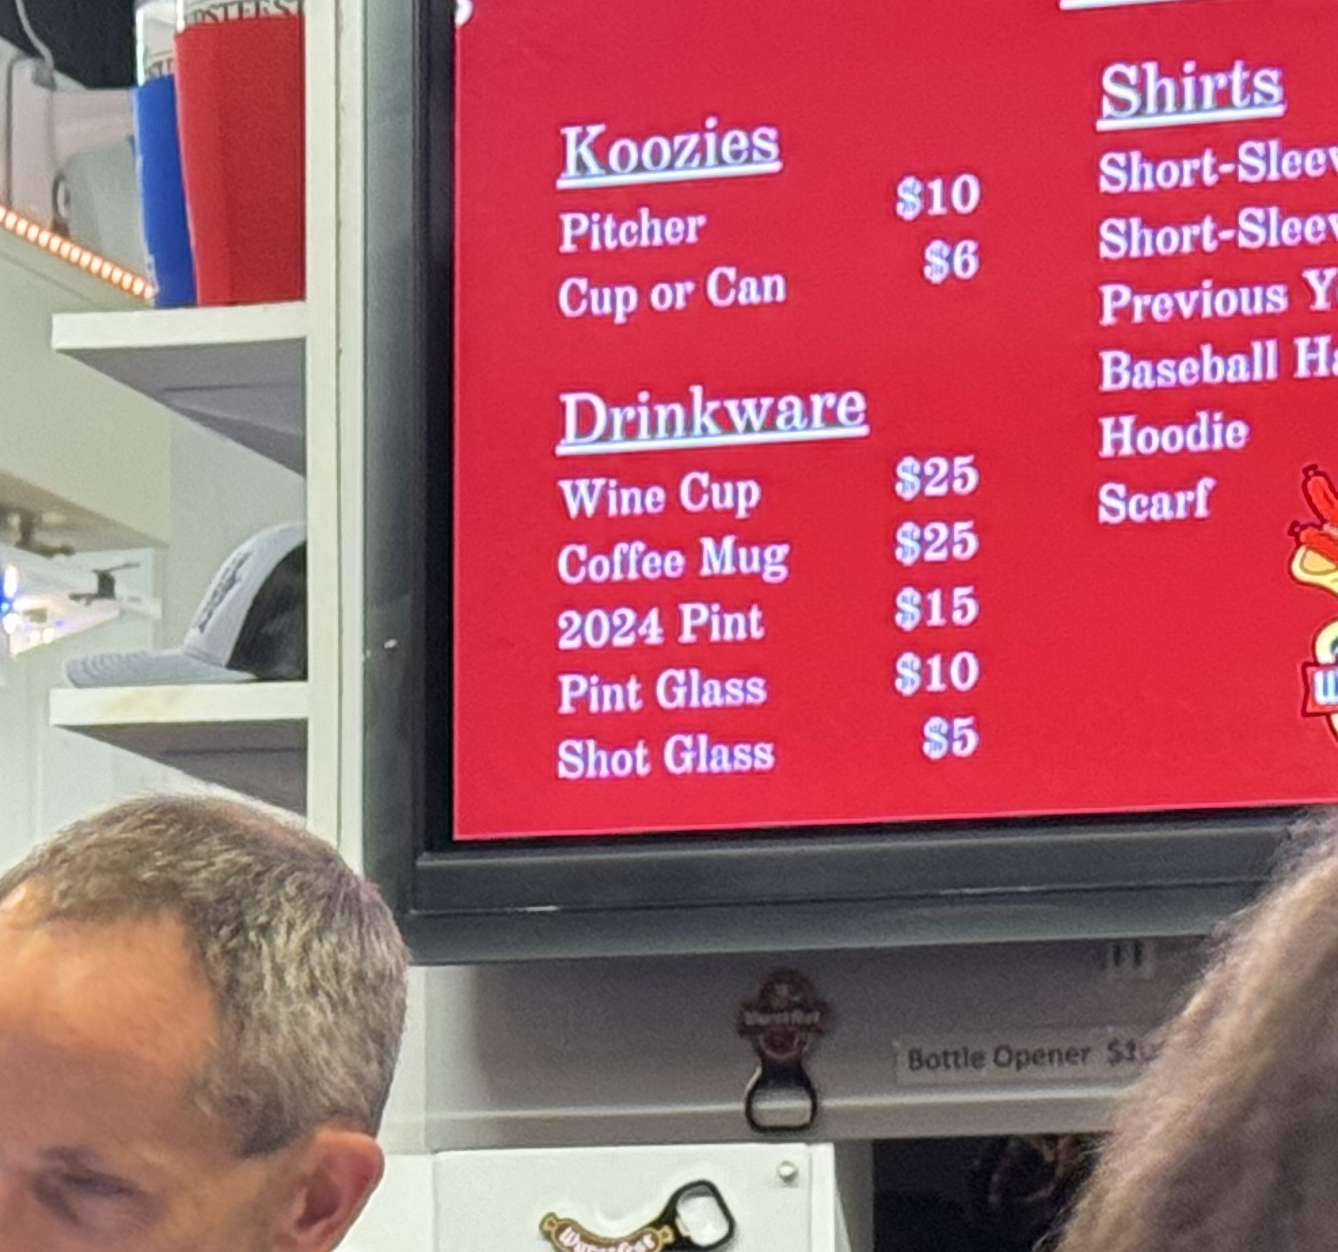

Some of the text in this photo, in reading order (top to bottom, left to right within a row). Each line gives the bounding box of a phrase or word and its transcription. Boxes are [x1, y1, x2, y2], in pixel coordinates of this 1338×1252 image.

[1102, 60, 1284, 119] Shirts
[560, 117, 781, 177] Koozies
[559, 173, 981, 254] Pitcher $10
[559, 239, 979, 324] Cup or Can $6
[1099, 267, 1338, 326] Previous Y
[1099, 339, 1278, 392] Baseball
[560, 385, 866, 445] Drinkware
[1099, 410, 1250, 458] Hoodie
[559, 455, 979, 518] Wine Cup $25
[1099, 476, 1217, 524] Scarf
[559, 521, 979, 584] Coffee Mug $25
[559, 586, 979, 650] 2024 Pint $15
[559, 652, 979, 714] Pint Glass $10
[557, 716, 978, 779] Shot Glass $5
[908, 1046, 985, 1072] Bottle
[993, 1045, 1091, 1072] Opener
